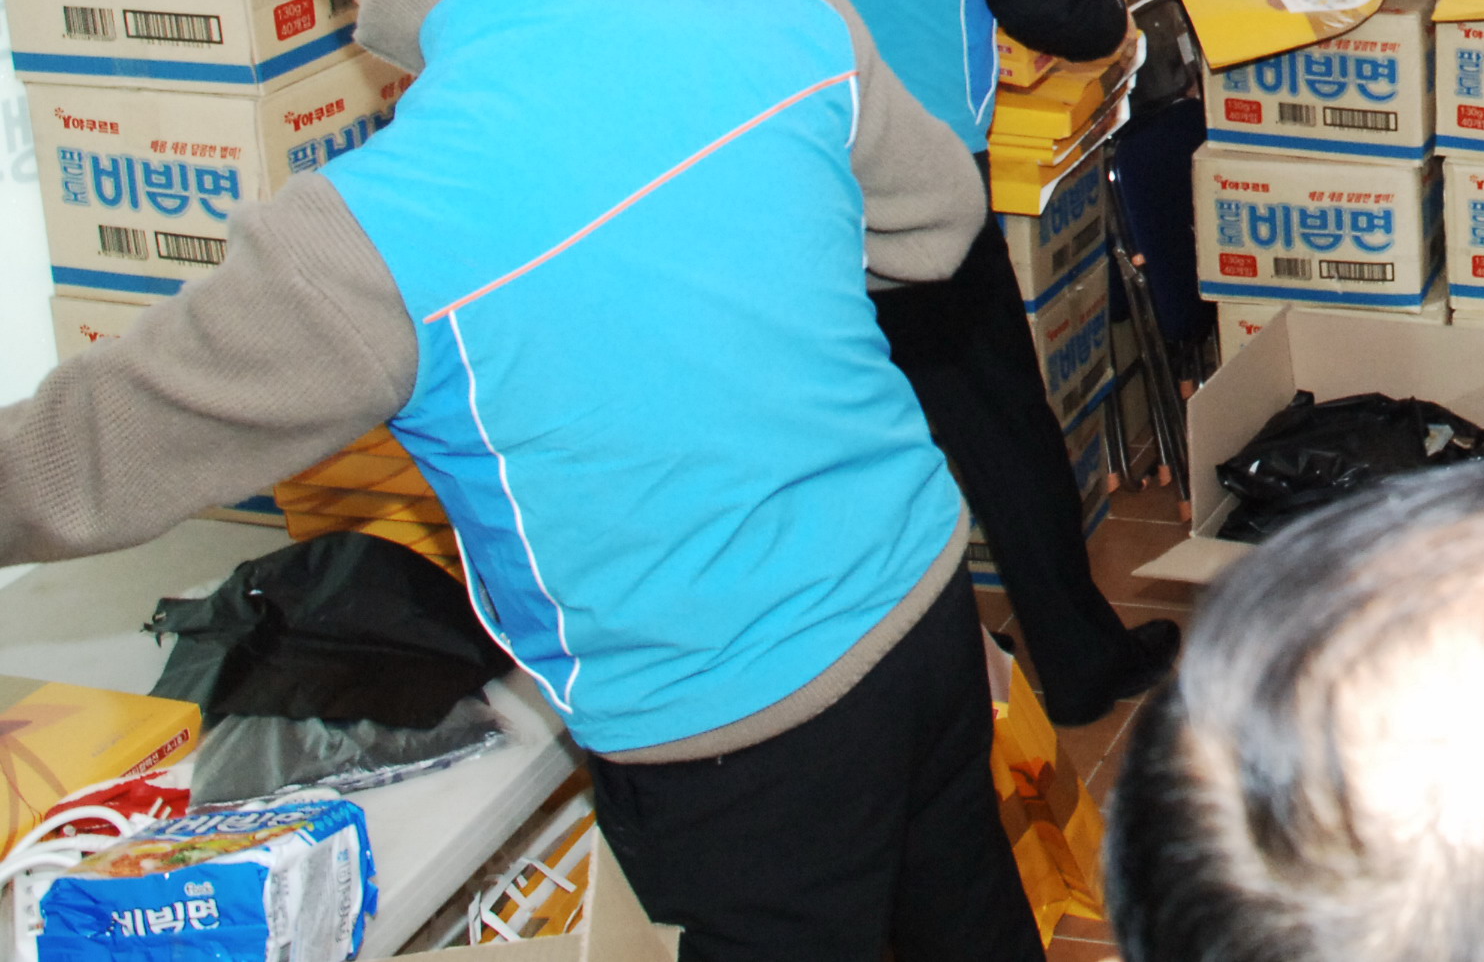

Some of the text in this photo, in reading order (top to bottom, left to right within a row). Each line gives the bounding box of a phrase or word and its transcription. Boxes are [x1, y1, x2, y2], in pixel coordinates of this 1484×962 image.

[1254, 52, 1399, 102] 비빔면
[88, 152, 242, 222] 비빔면
[1248, 204, 1394, 252] 비빔면
